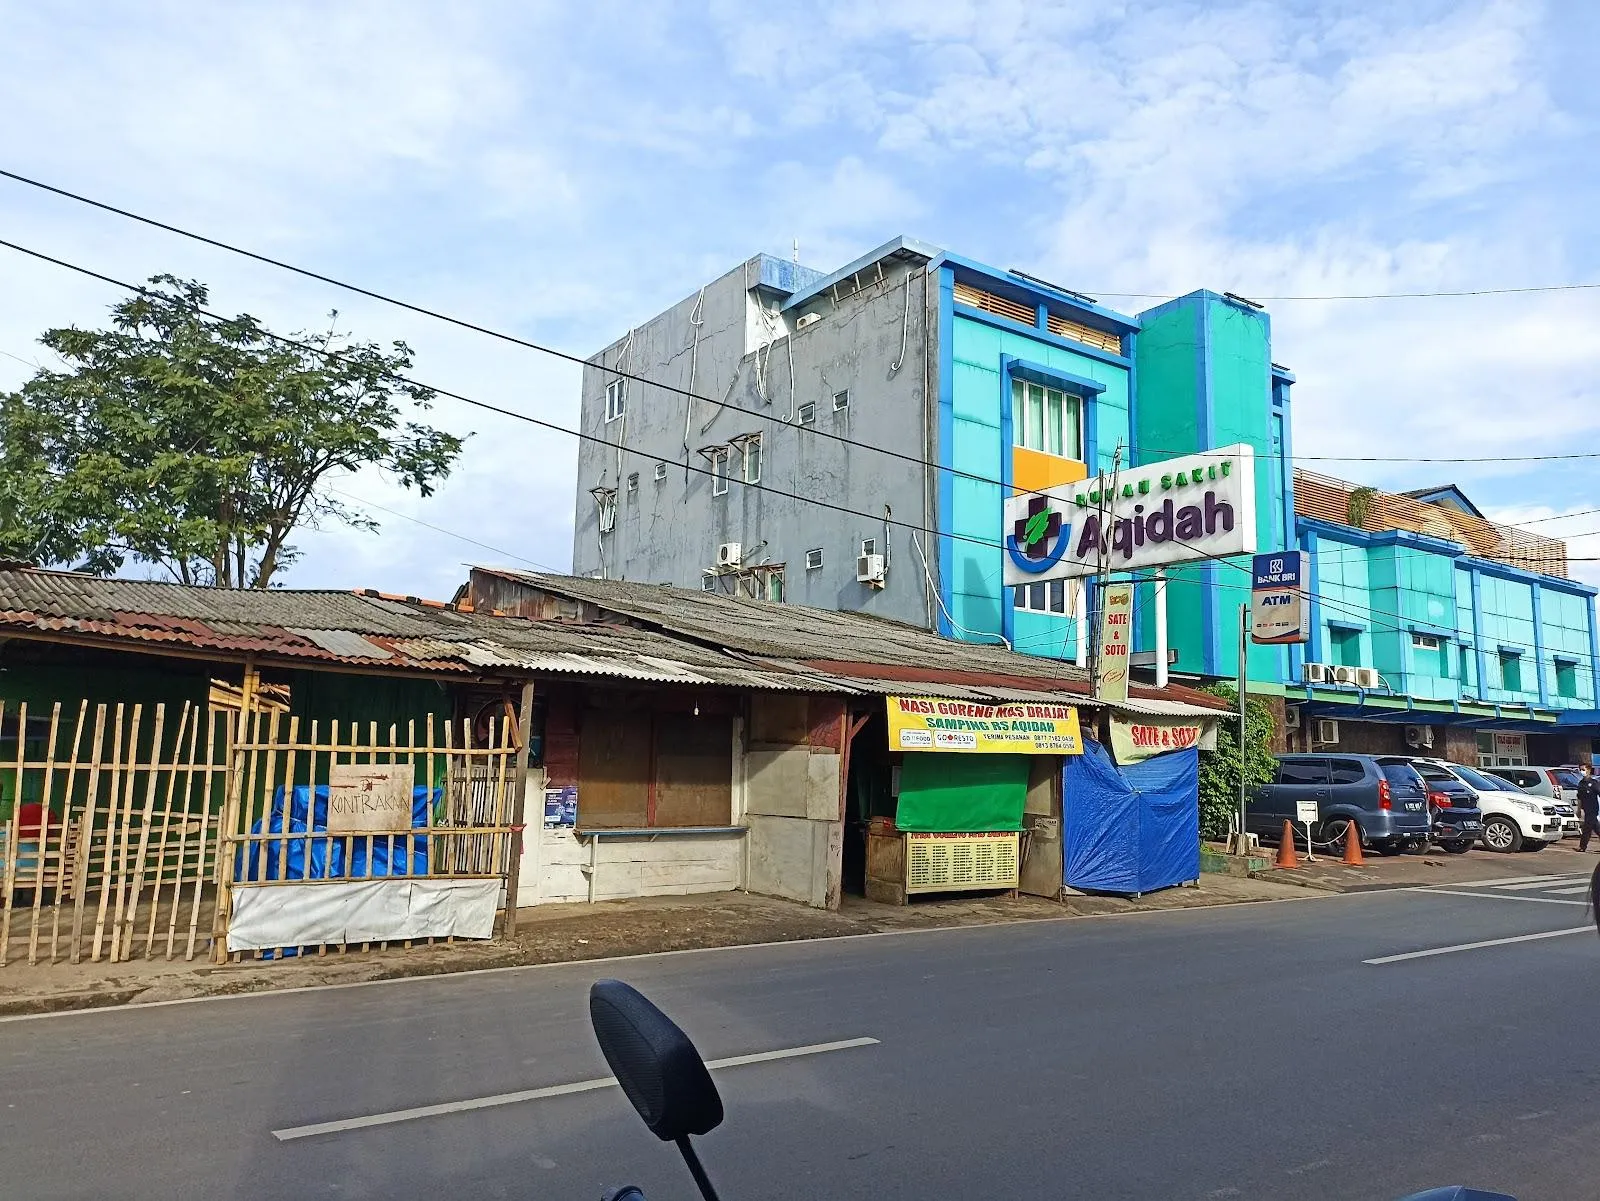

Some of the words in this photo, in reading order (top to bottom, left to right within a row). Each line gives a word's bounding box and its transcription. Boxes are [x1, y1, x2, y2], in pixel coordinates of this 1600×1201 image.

[1161, 462, 1232, 490] SAKIT
[1077, 491, 1234, 559] Aqidah
[1257, 574, 1280, 583] BANK
[1282, 573, 1296, 582] BRI
[1262, 595, 1291, 606] ATM
[1109, 614, 1127, 624] SATE
[1114, 631, 1119, 639] &
[1105, 645, 1126, 655] SOTO
[900, 699, 935, 713] NASI
[938, 703, 994, 718] GORENG
[996, 706, 1024, 718] MAS
[1027, 706, 1069, 719] DRAJAT
[926, 718, 989, 731] SAMPING
[991, 721, 1009, 731] RS
[1012, 721, 1055, 732] AQIDAH
[1131, 725, 1160, 746] SATE
[1162, 730, 1170, 746] &
